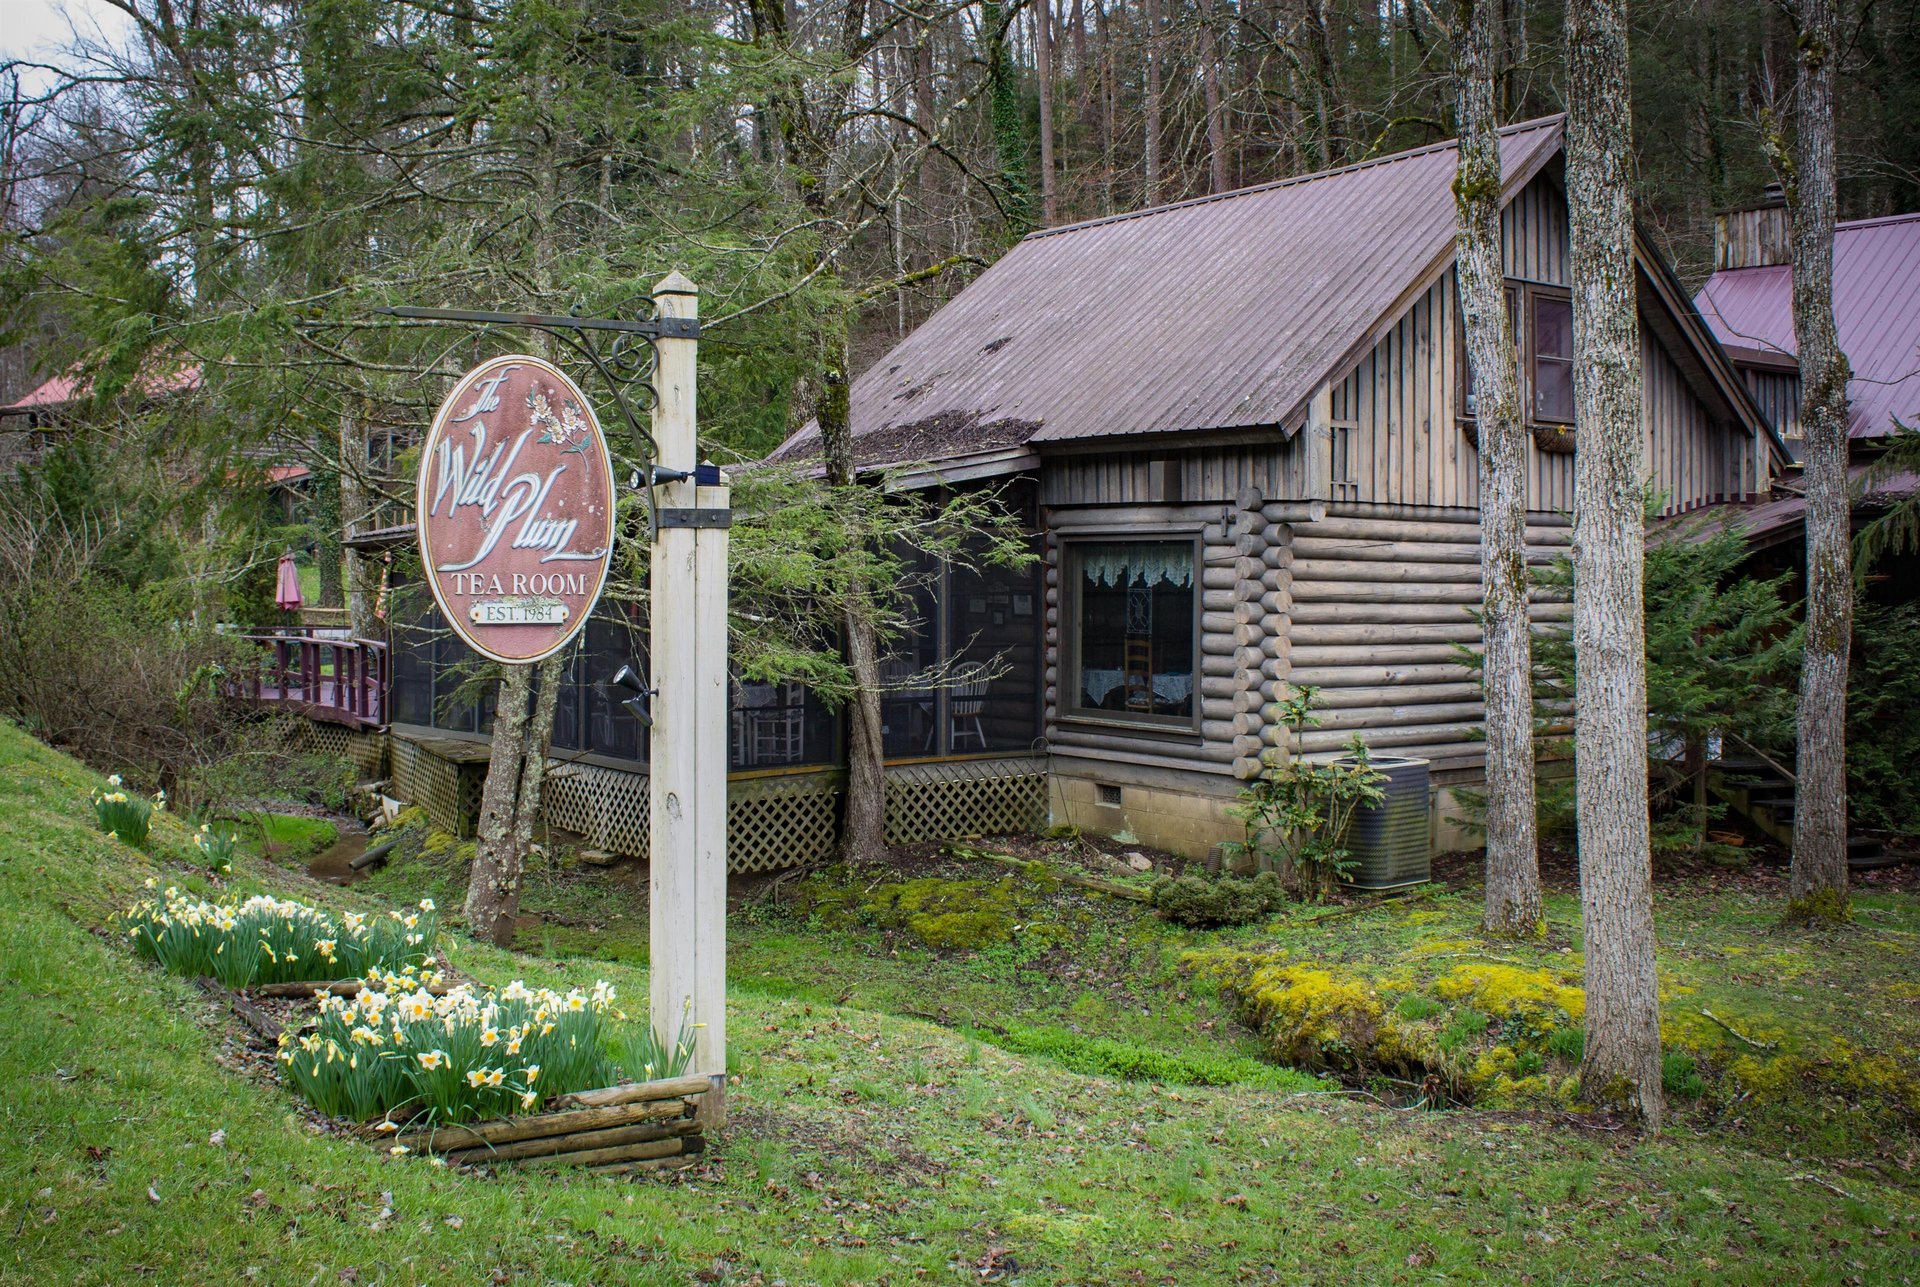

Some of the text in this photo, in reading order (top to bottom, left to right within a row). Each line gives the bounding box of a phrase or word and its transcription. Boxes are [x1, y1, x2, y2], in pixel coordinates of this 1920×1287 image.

[451, 365, 522, 422] The
[430, 419, 533, 518] Wild
[437, 463, 607, 572] Plum
[451, 573, 586, 595] TEA ROOM
[486, 606, 552, 621] EST. 1984
